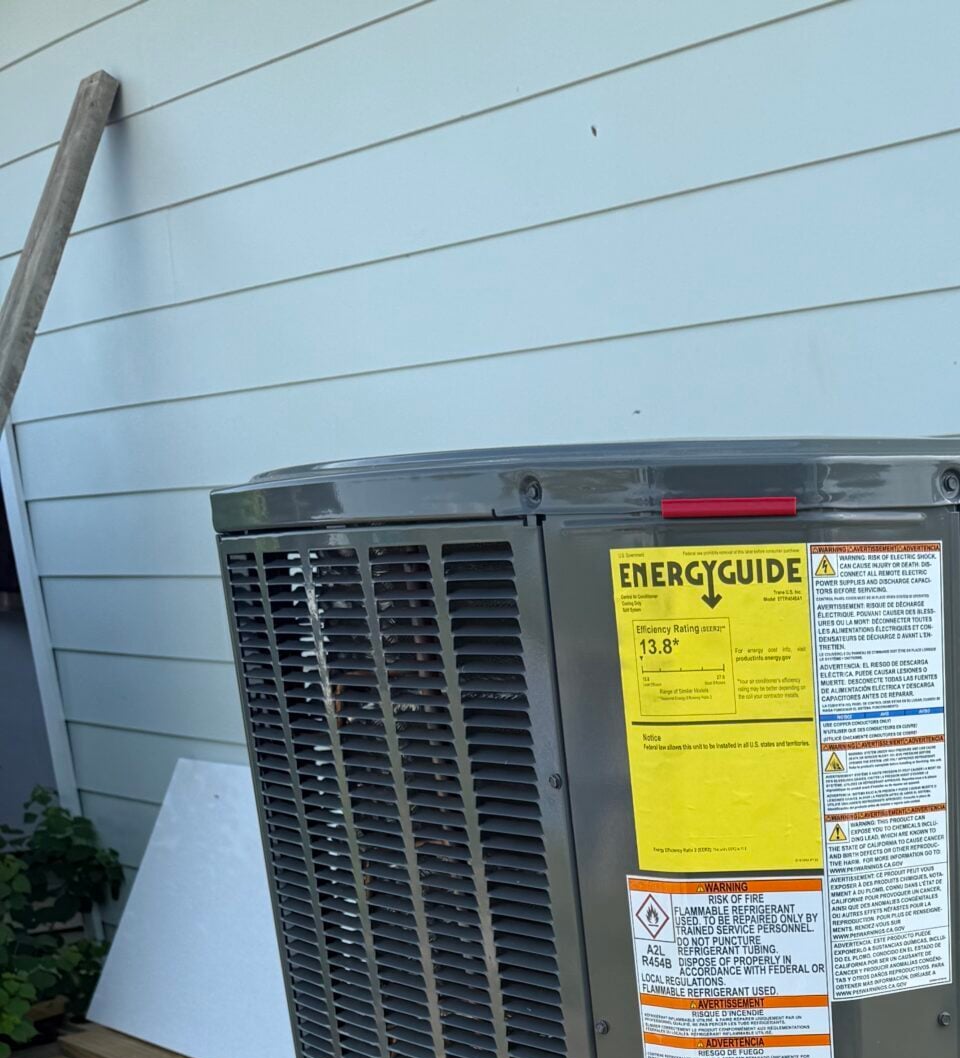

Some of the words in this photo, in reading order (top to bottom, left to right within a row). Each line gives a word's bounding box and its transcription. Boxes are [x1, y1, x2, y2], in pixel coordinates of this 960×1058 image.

[619, 558, 802, 589] ENERGYGUIDE
[636, 625, 671, 635] Efficiency
[673, 624, 700, 634] Rating
[643, 734, 661, 742] Notice
[889, 816, 913, 824] PRODUCT
[851, 827, 871, 835] EXPOSE
[891, 823, 920, 831] CHEMICALS
[866, 839, 897, 848] CALIFORNIA
[923, 834, 944, 842] CANCER
[704, 882, 748, 892] WARNING
[708, 895, 728, 904] RISK
[730, 894, 741, 904] OF
[744, 894, 764, 904] FIRE
[674, 905, 728, 916] FLAMMABLE
[731, 904, 795, 915] REFRIGERANT
[675, 915, 701, 925] USED.
[704, 915, 715, 925] TO
[717, 915, 730, 924] BE
[732, 914, 777, 924] REPAIRED
[779, 914, 802, 923] ONLY
[805, 913, 818, 923] BY
[676, 925, 713, 935] TRAINED
[716, 924, 754, 935] SERVICE
[757, 923, 814, 934] PERSONNEL.
[677, 937, 689, 946] DO
[691, 936, 708, 945] NOT
[712, 936, 761, 945] PUNCTURE
[647, 945, 665, 956] A2L
[678, 945, 738, 956] REFRIGERANT
[743, 945, 778, 954] TUBING.
[641, 955, 672, 969] R454B
[679, 957, 716, 966] DISPOSE
[718, 956, 730, 966] OF
[733, 955, 779, 965] PROPERLY
[782, 955, 791, 965] IN
[679, 966, 741, 976] ACCORDANCE
[743, 965, 766, 975] WITH
[768, 964, 809, 974] FEDERAL
[811, 963, 825, 973] OR
[642, 973, 664, 984] LOCAL
[665, 975, 726, 986] REGULATIONS.
[642, 984, 684, 997] FLAMMABLE
[687, 987, 748, 997] REFRIGERANT
[751, 986, 779, 996] USED.
[698, 998, 764, 1008] AVERTISSEMENT
[706, 1037, 764, 1047] ADVERTENCIA
